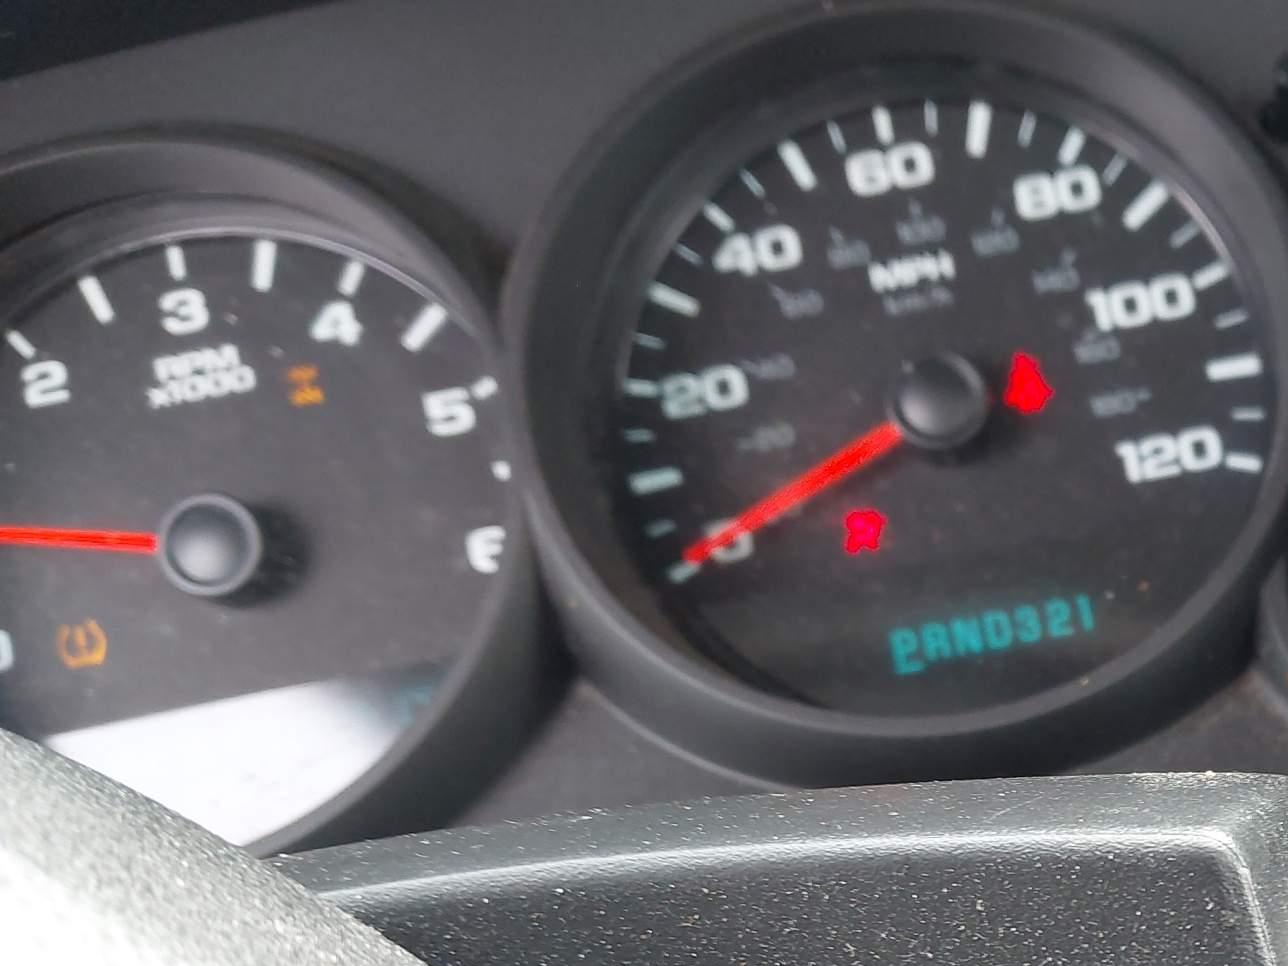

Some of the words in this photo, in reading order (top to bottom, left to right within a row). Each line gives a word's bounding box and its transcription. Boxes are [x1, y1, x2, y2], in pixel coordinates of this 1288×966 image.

[844, 141, 935, 198] 60
[1012, 164, 1102, 221] 80
[711, 223, 804, 276] 40
[867, 250, 956, 293] MPH
[158, 286, 211, 336] 3
[310, 300, 363, 347] 4
[1084, 272, 1197, 333] 100
[21, 359, 72, 408] 2
[153, 343, 241, 385] RPM
[421, 386, 477, 437] 5
[660, 363, 750, 420] 20
[1114, 425, 1224, 485] 120
